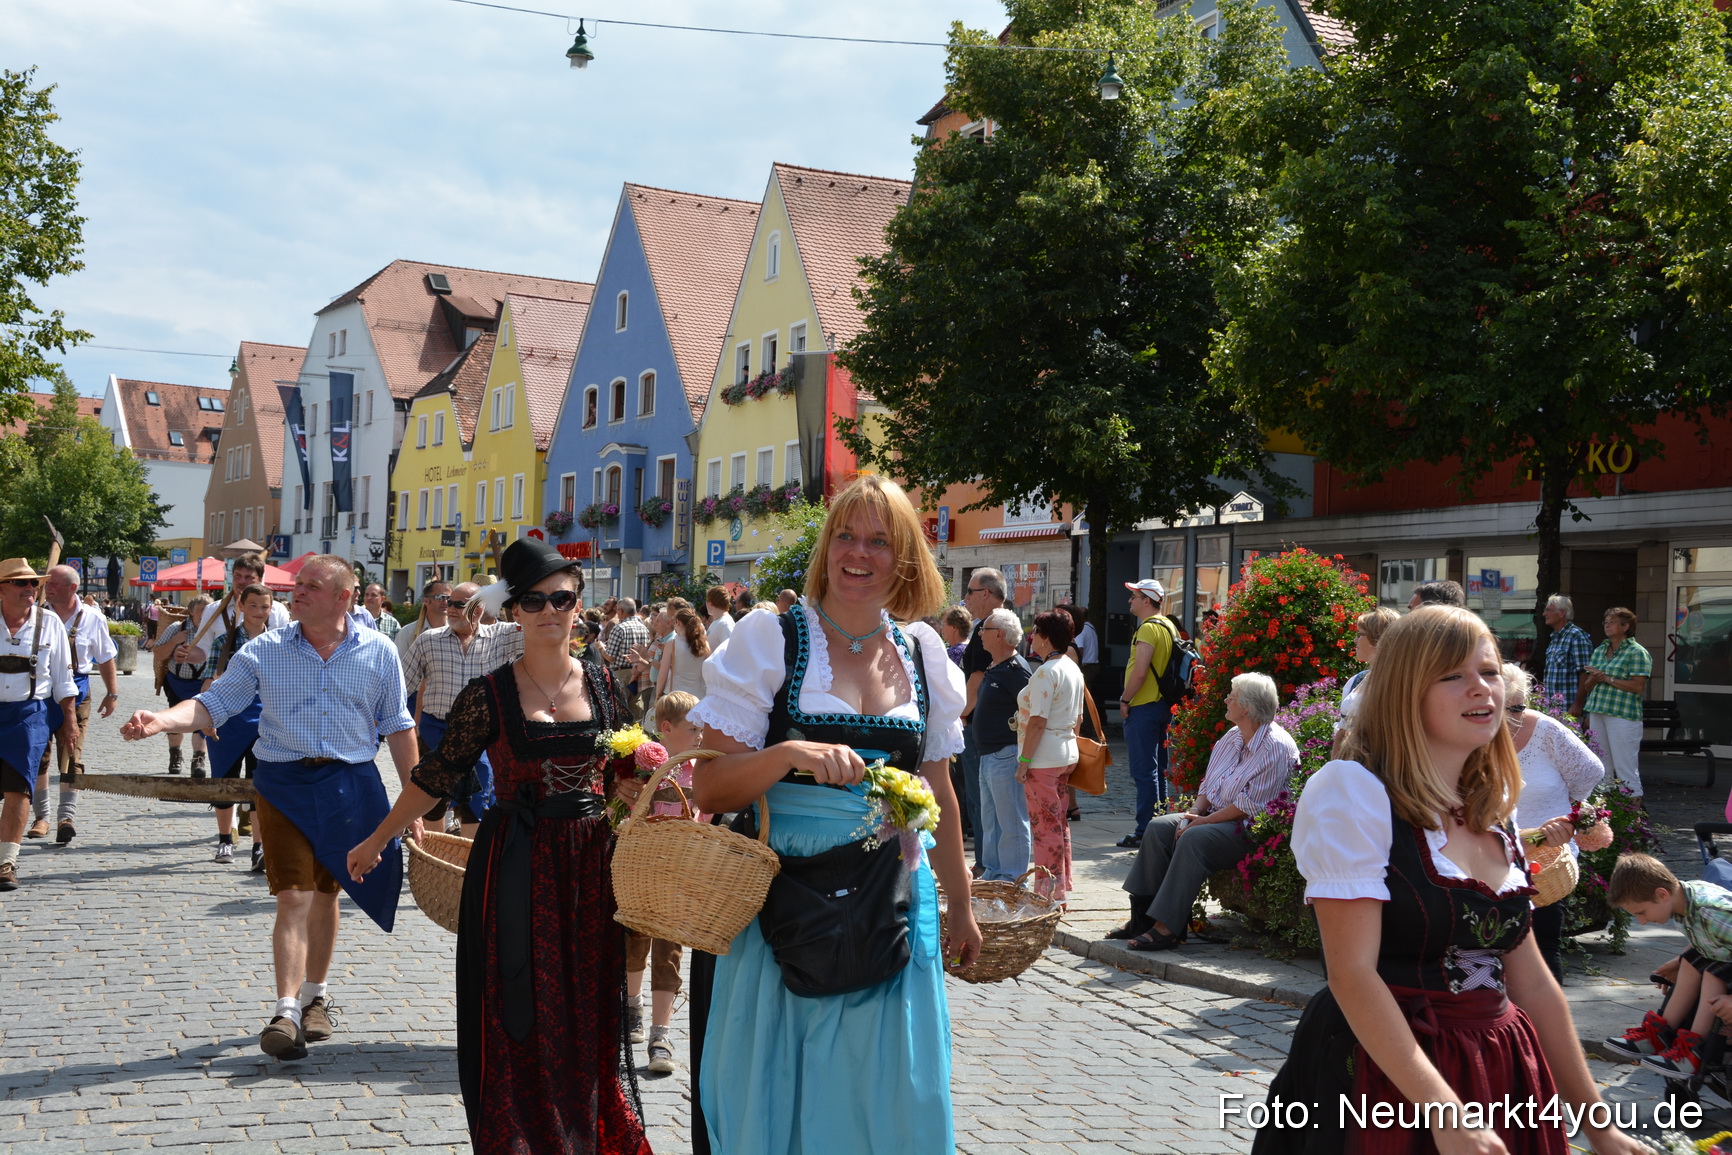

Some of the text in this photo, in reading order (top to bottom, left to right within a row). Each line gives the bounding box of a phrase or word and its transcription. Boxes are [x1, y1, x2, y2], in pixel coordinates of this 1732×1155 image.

[333, 420, 350, 462] K&L
[425, 466, 442, 482] HOTEL
[939, 510, 947, 536] P
[711, 543, 722, 563] P
[141, 573, 157, 582] TAXI
